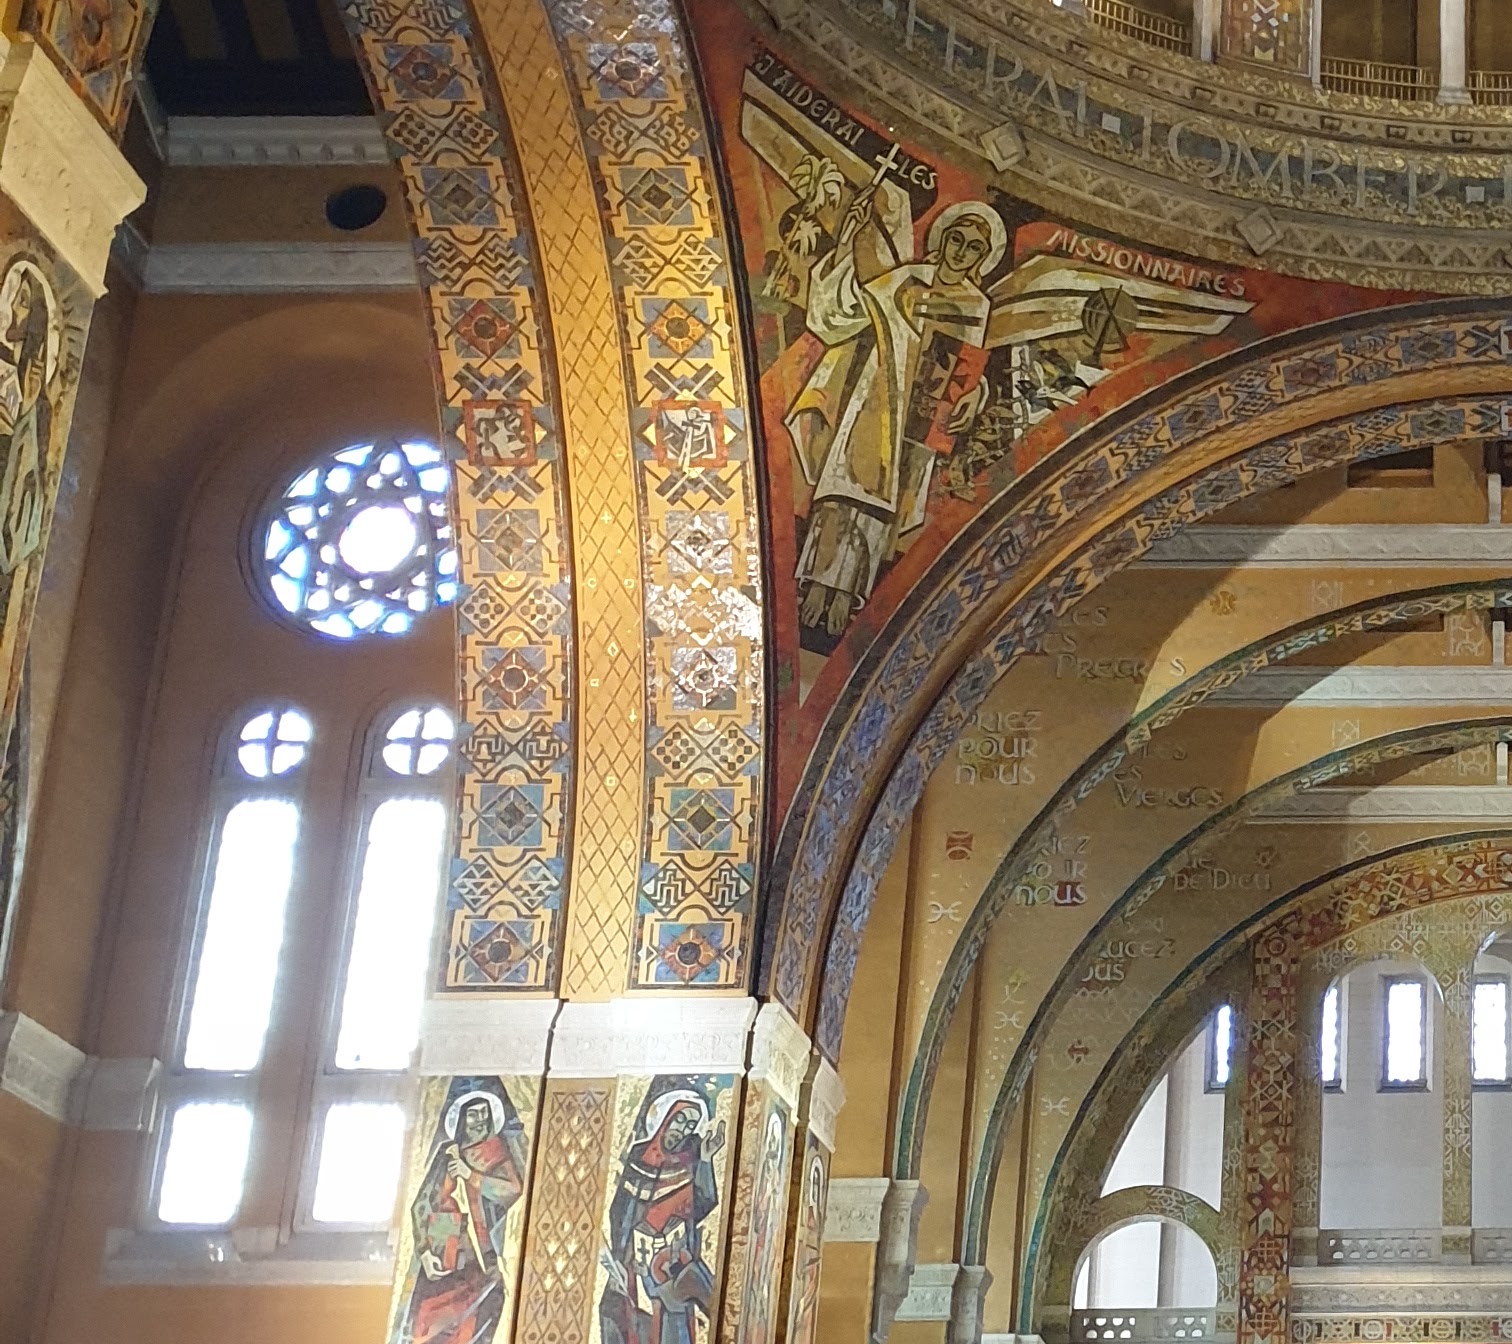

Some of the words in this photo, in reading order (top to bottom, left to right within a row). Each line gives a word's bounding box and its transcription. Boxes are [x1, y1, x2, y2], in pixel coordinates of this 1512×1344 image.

[752, 54, 865, 146] J'AIDERAI
[898, 158, 938, 192] LES
[1046, 226, 1246, 297] MISSIONNAIRES
[957, 736, 1040, 760] POUR
